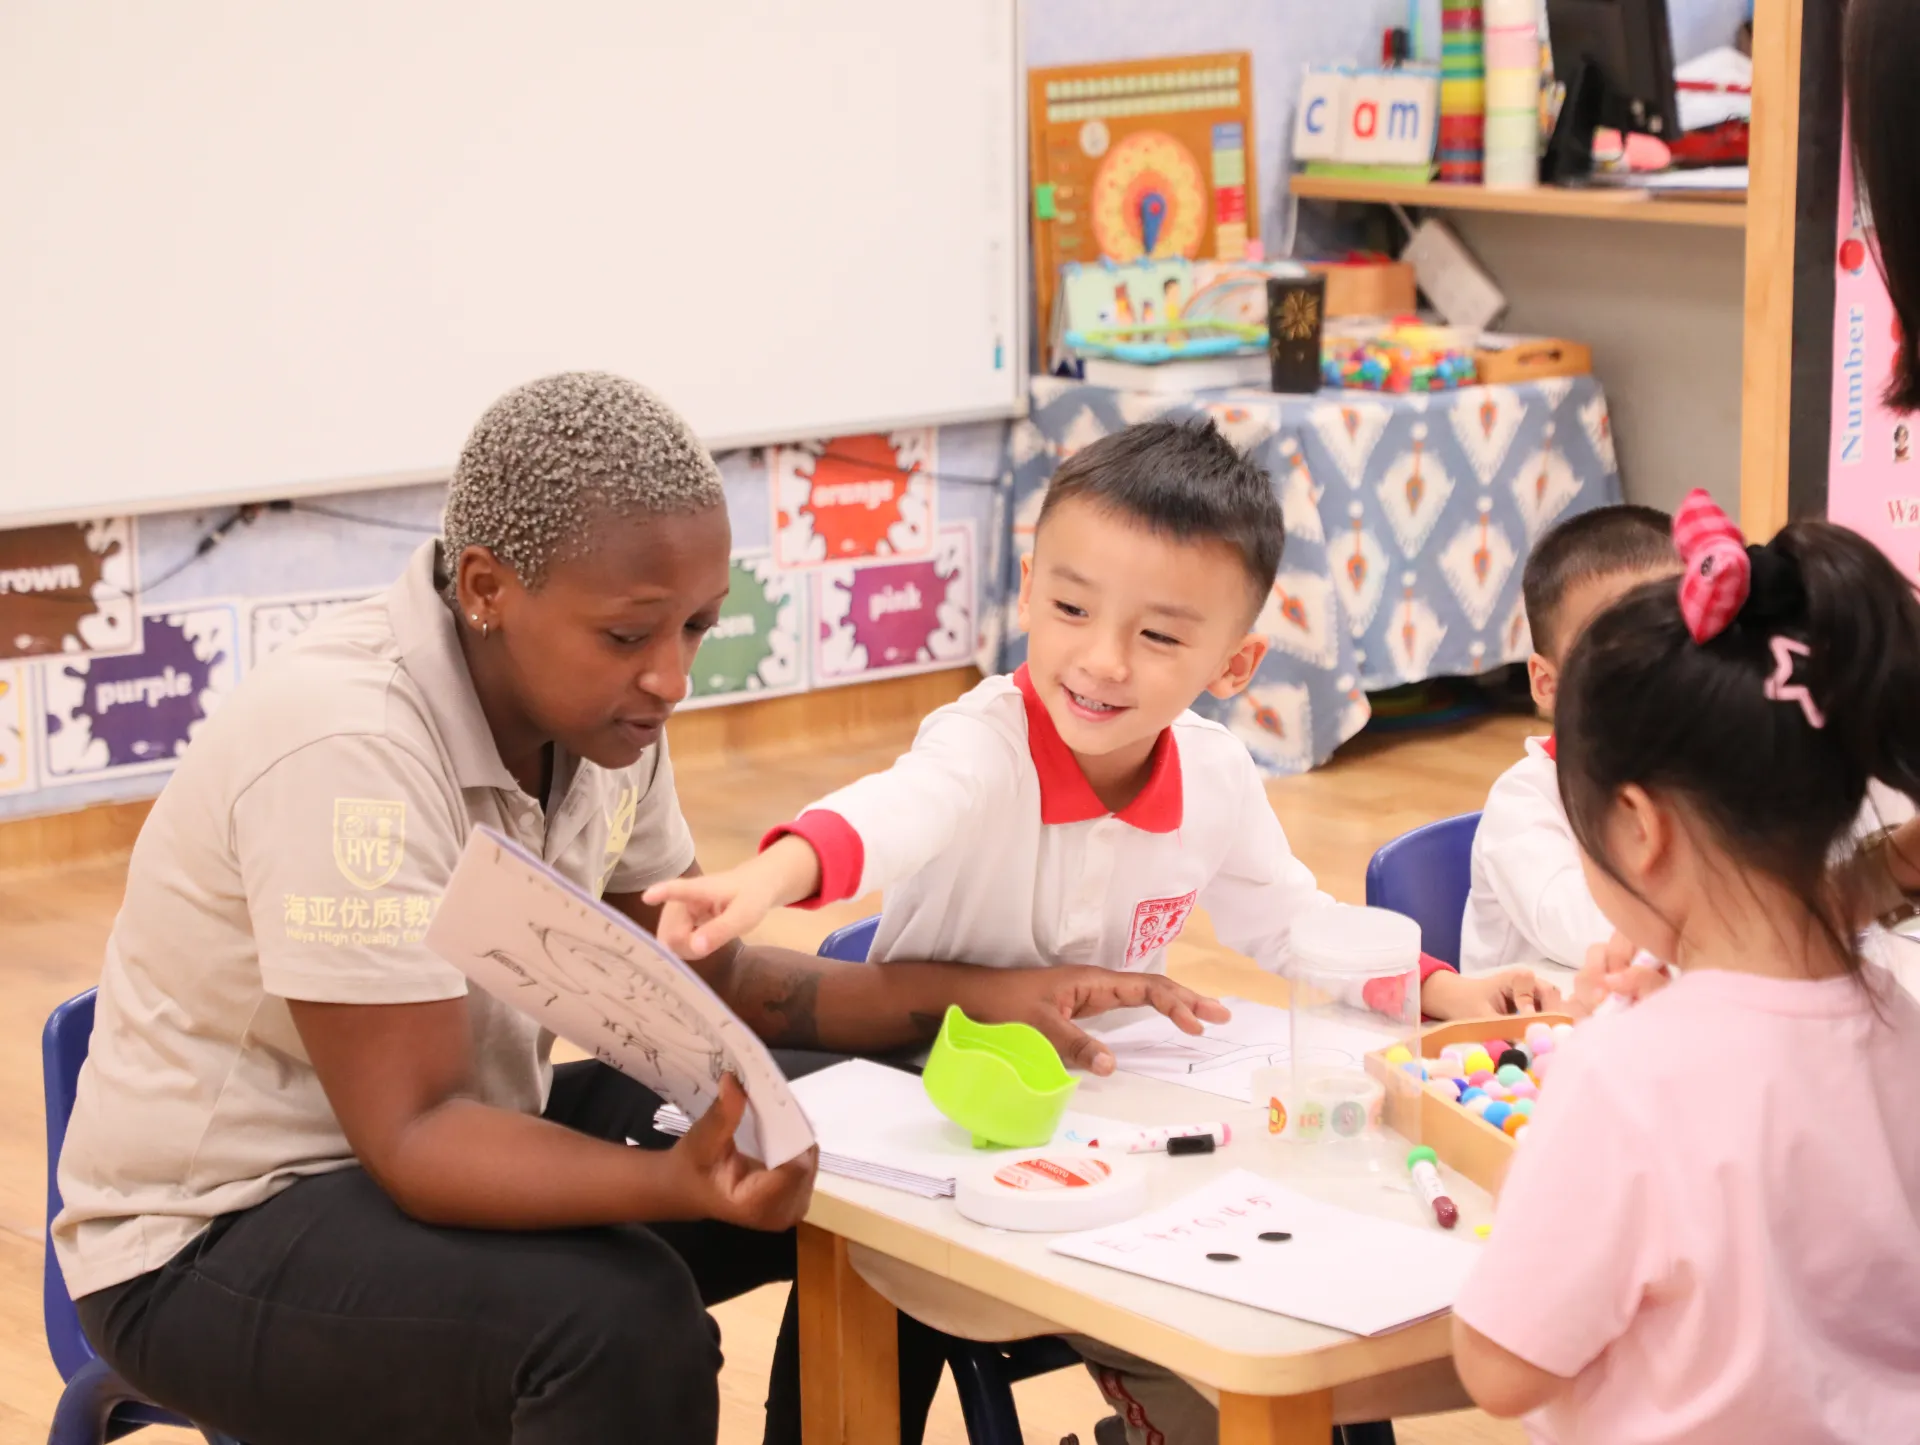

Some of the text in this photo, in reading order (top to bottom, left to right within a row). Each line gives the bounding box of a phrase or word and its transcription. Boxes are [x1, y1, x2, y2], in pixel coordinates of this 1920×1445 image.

[1842, 306, 1863, 460] Number
[812, 480, 894, 510] orange
[1887, 499, 1920, 523] Wa
[0, 564, 82, 595] rown
[868, 582, 922, 622] pink
[95, 665, 192, 714] purple
[347, 838, 392, 873] HYE
[283, 893, 442, 929] 海亚优质教
[318, 931, 348, 946] High
[352, 931, 399, 947] Quality
